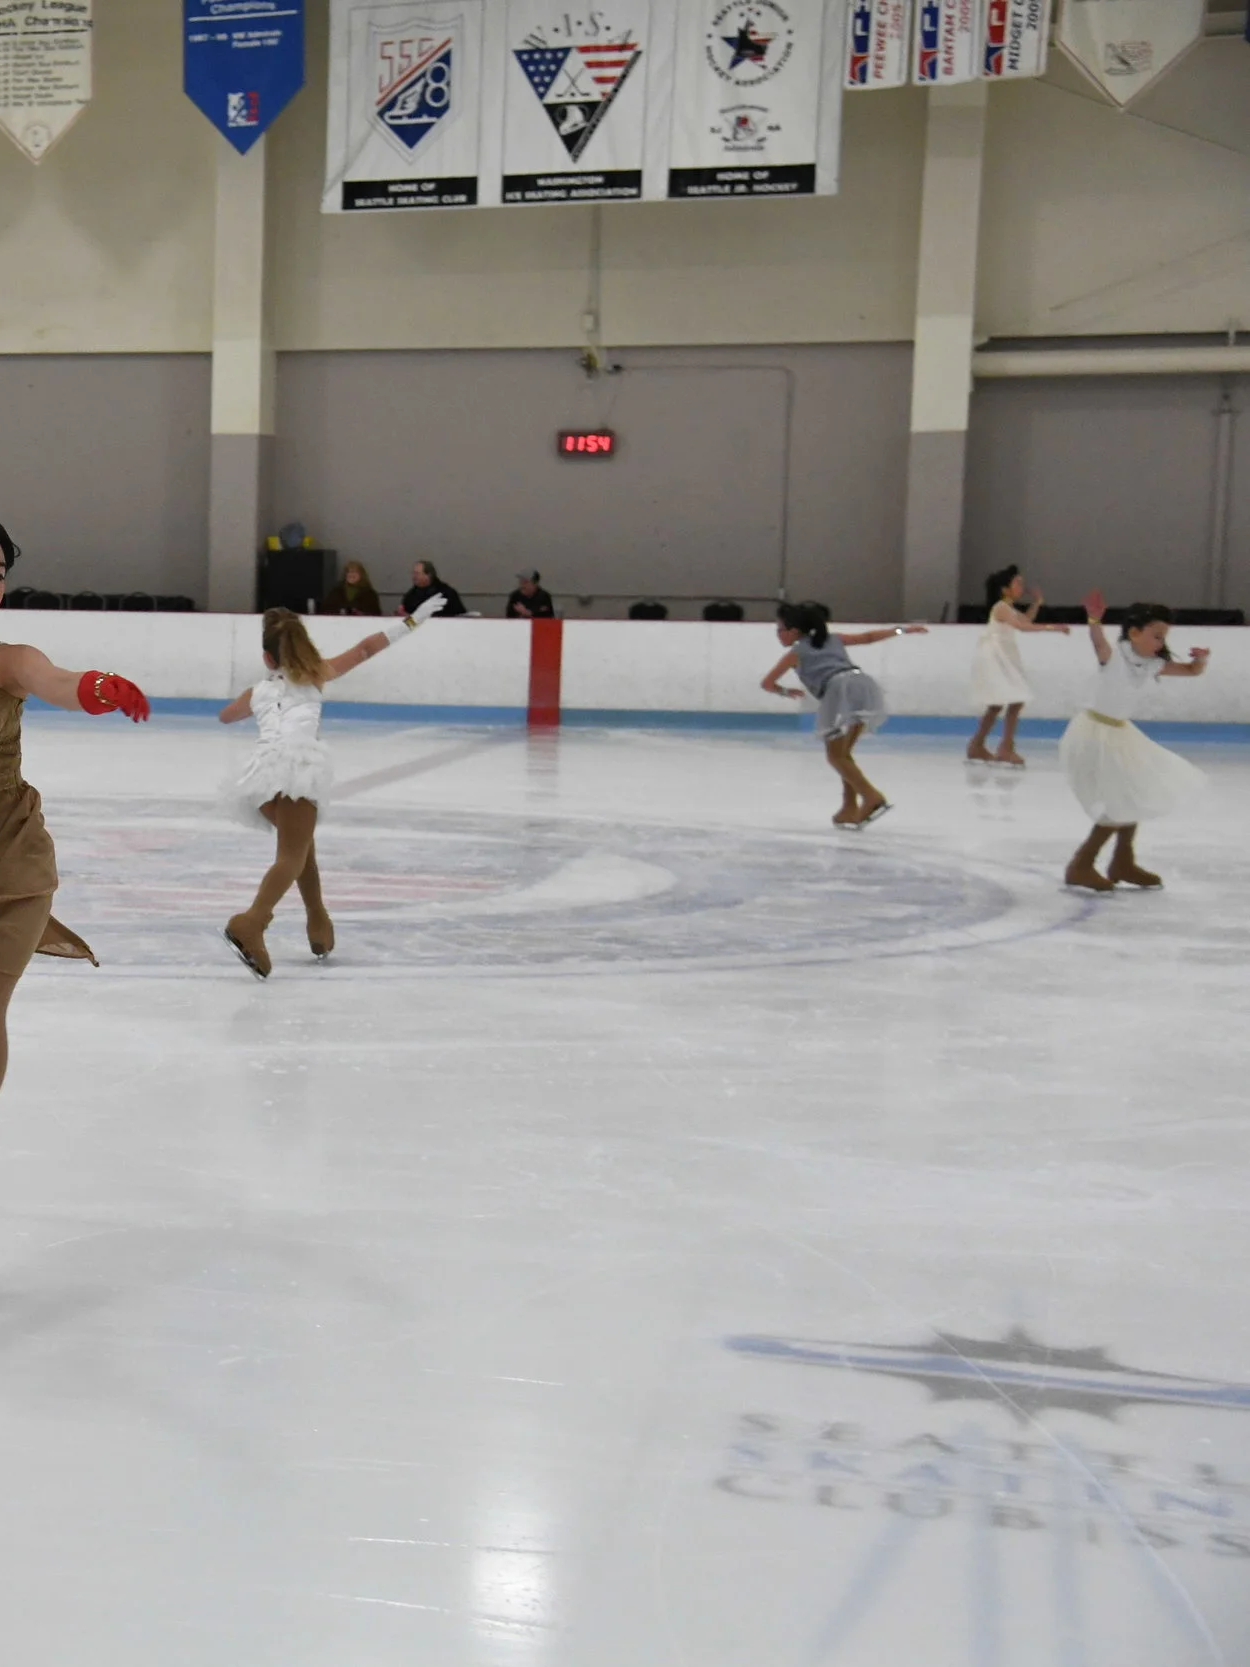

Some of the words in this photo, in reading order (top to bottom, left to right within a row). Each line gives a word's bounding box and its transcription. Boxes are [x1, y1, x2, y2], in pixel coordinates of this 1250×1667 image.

[42, 0, 88, 13] League
[942, 14, 955, 76] BANTAM
[1007, 11, 1023, 71] MIDGET
[715, 171, 750, 181] HOME
[752, 170, 769, 180] OF
[420, 182, 437, 192] OF
[752, 182, 798, 192] HOCKEY
